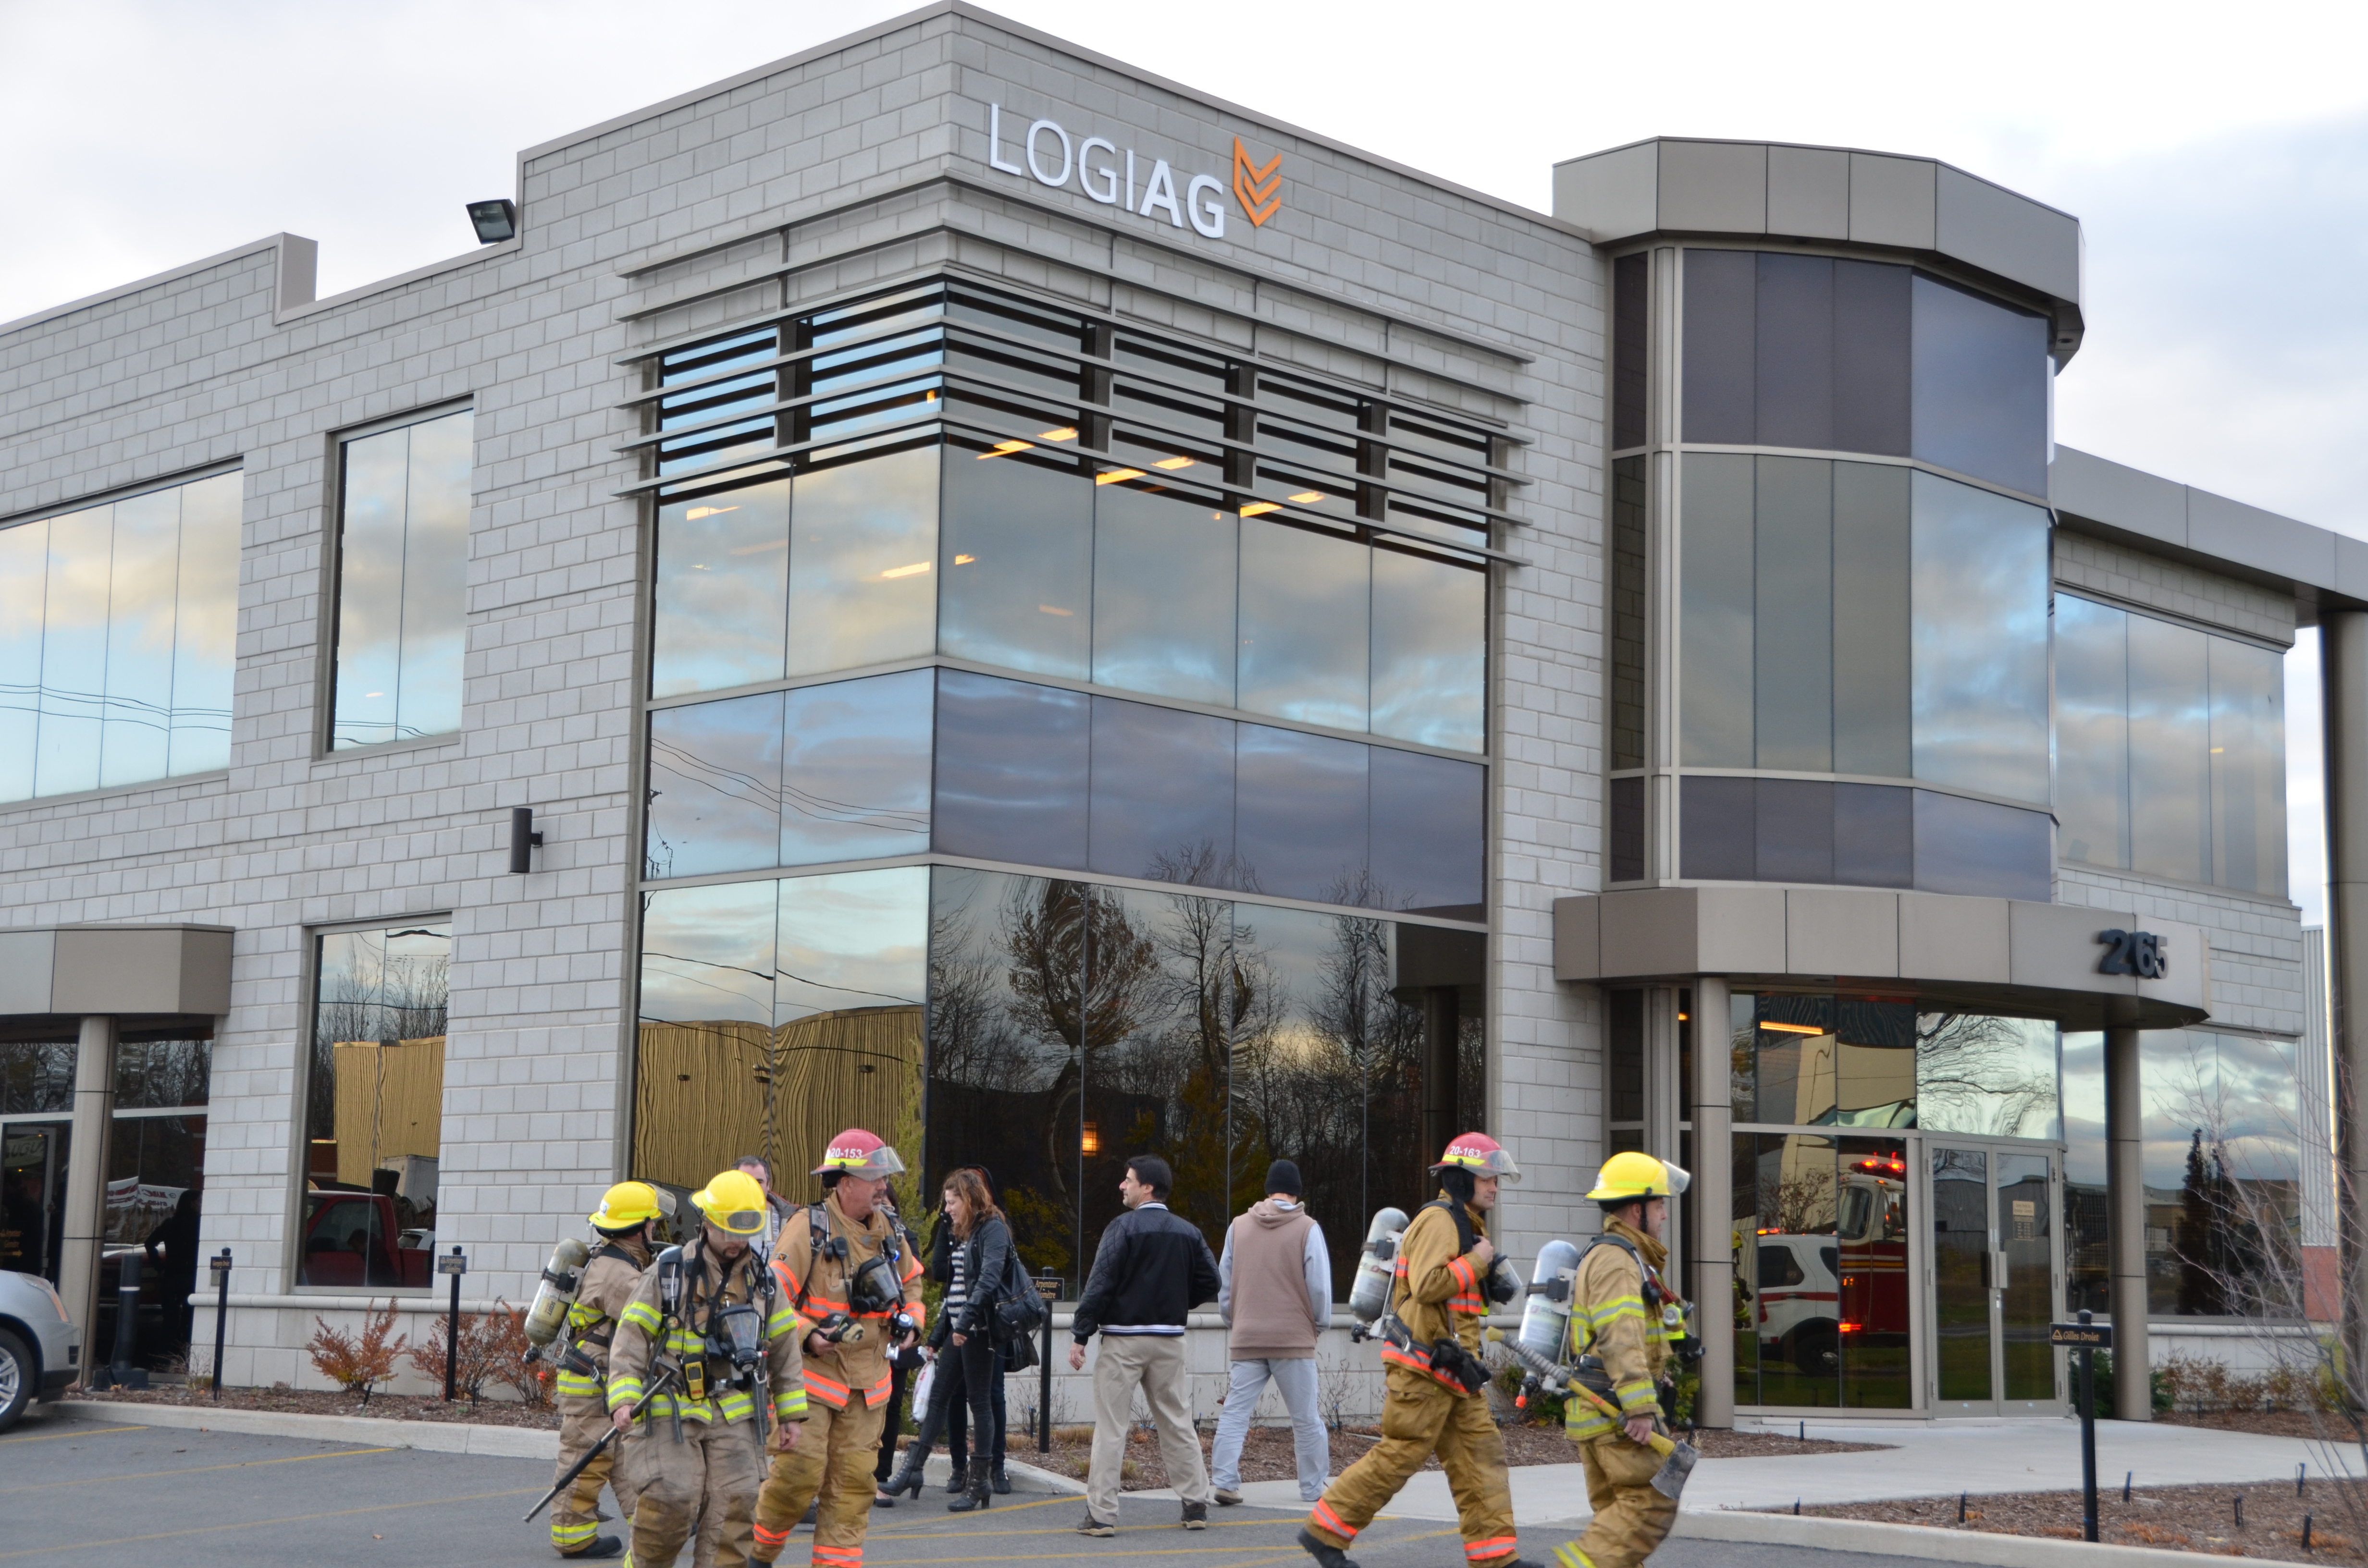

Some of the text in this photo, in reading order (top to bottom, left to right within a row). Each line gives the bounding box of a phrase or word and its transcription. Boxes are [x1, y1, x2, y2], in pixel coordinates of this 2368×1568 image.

[990, 103, 1224, 238] LOGIAG
[2098, 929, 2169, 980] 265
[830, 1148, 863, 1159] 20-153
[1449, 1146, 1480, 1158] 20-163
[1035, 1280, 1058, 1292] Arpenteur
[547, 1301, 555, 1316] SCOTT
[2063, 1331, 2099, 1341] Gilles Drolet
